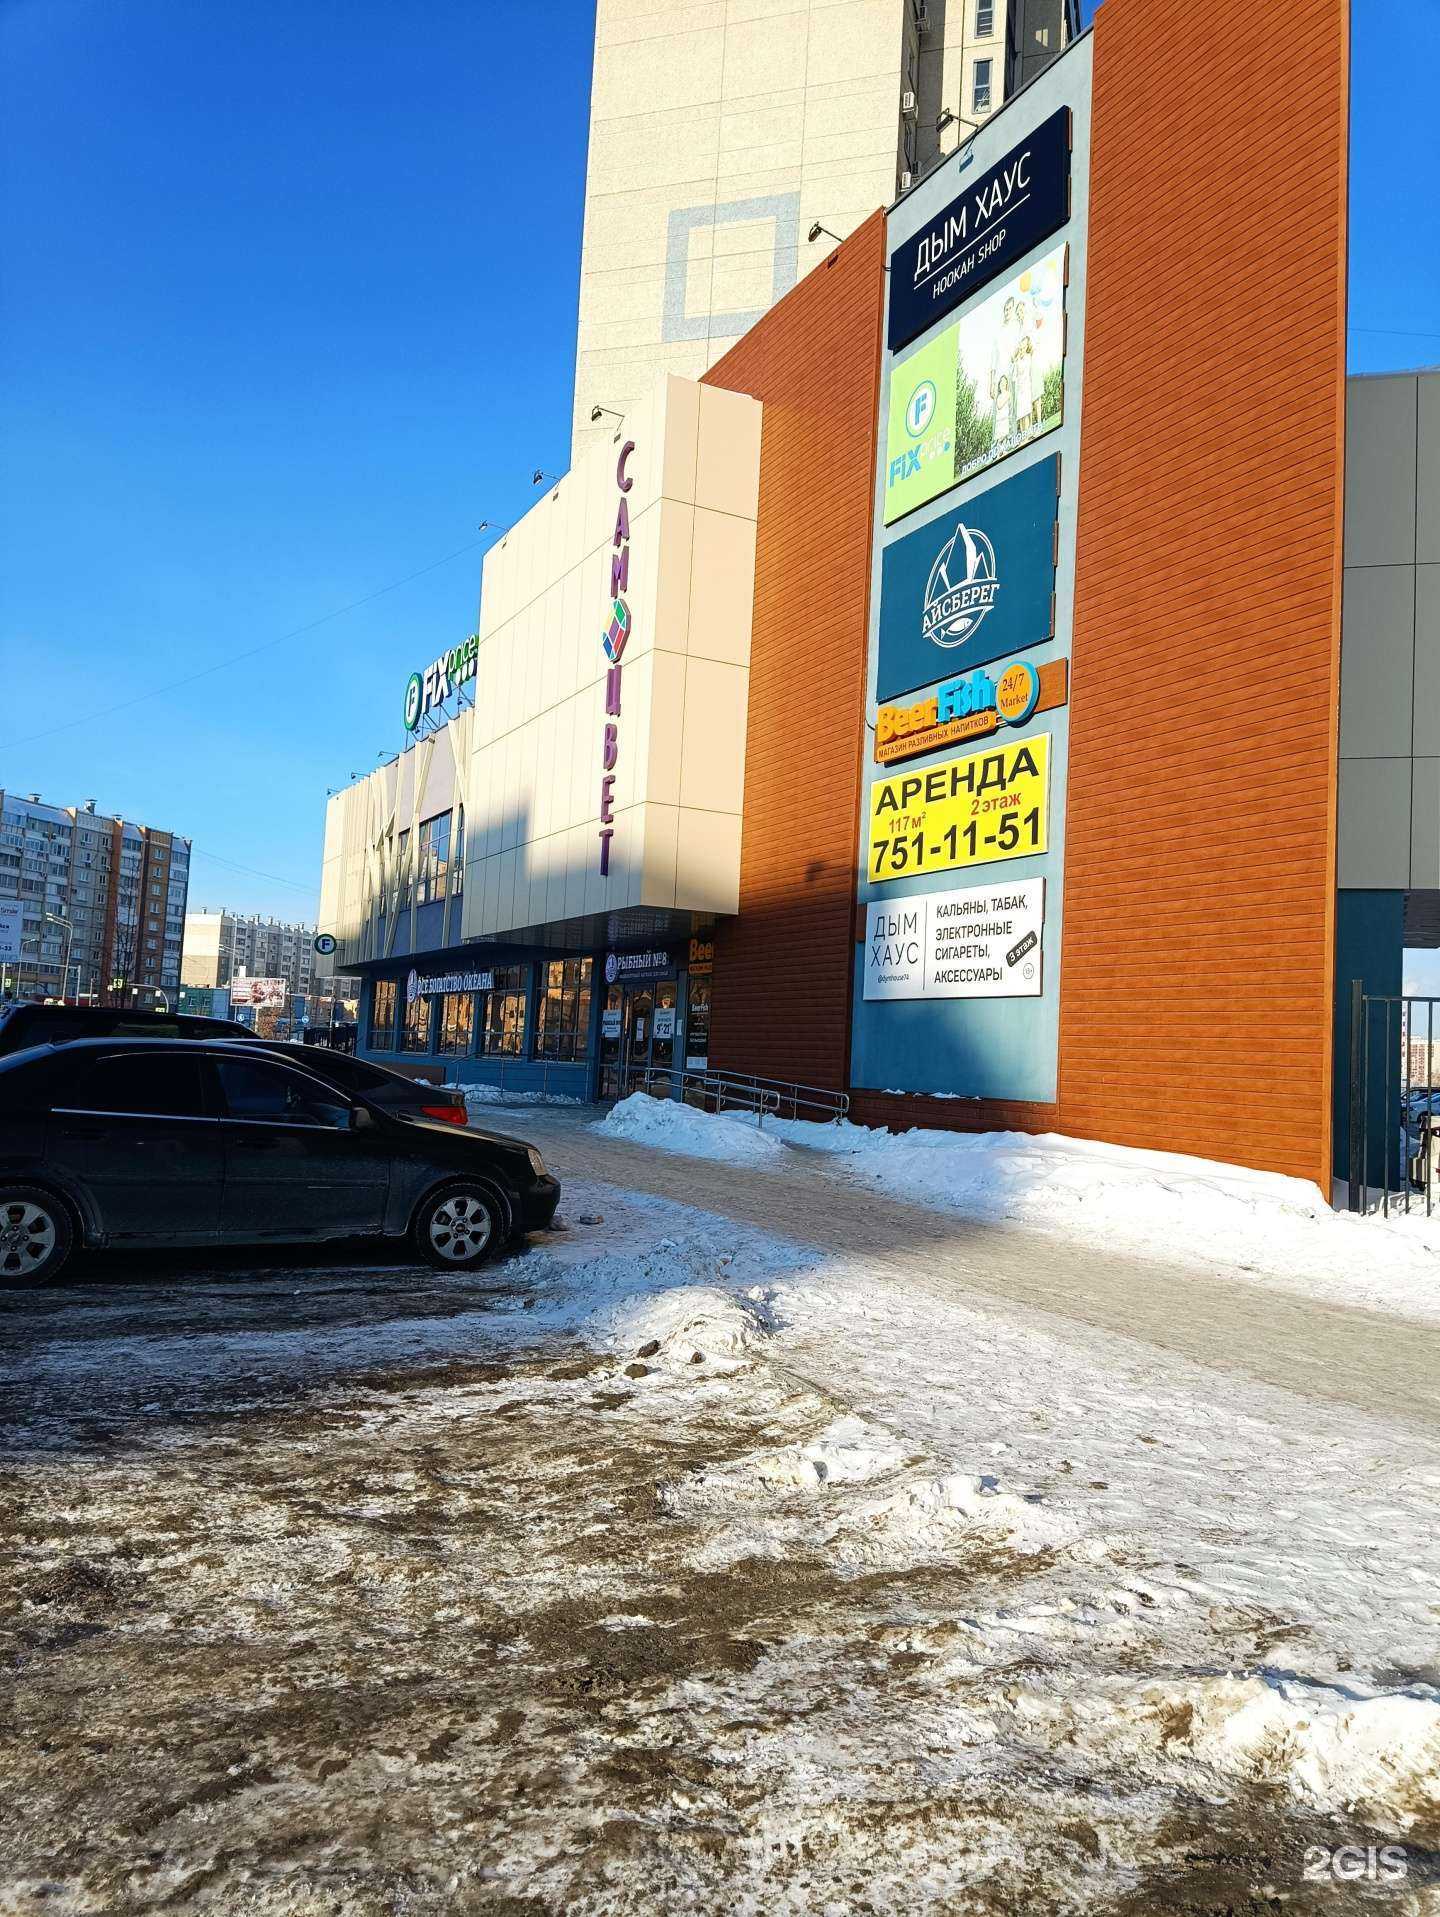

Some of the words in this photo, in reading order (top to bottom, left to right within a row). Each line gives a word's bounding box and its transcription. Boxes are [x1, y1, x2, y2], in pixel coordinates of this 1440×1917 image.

[914, 206, 967, 282] ДЫМ
[974, 151, 1031, 228] ХАУС
[932, 254, 975, 299] HOOKAH
[977, 229, 1006, 264] SHOP
[922, 583, 1000, 634] АЙСБЕРЕГ
[1002, 672, 1025, 692] 24/7
[1000, 693, 1029, 710] Market
[878, 742, 907, 759] МАГАЗИН
[907, 730, 949, 749] РАЗЛИВНЫХ
[950, 716, 989, 736] НАПИТКОВ
[875, 747, 1039, 816] АРЕНДА
[873, 806, 1040, 874] 751-11-51
[936, 901, 989, 919] КАЛЬЯНЫ,
[991, 894, 1028, 912] ТАБАК,
[874, 912, 918, 942] ДЫМ
[935, 921, 1013, 941] ЭЛЕКТРОННЫЕ
[616, 949, 652, 970] РЫБНЫЙ
[870, 942, 919, 967] ХАУС
[935, 944, 991, 961] СИГАРЕТЫ,
[1009, 951, 1016, 962] 3
[1015, 936, 1034, 957] этаж
[428, 975, 463, 994] БОГАТСТВО
[463, 972, 492, 991] ОКЕАНА
[934, 967, 1003, 984] АКСЕССУАРЫ
